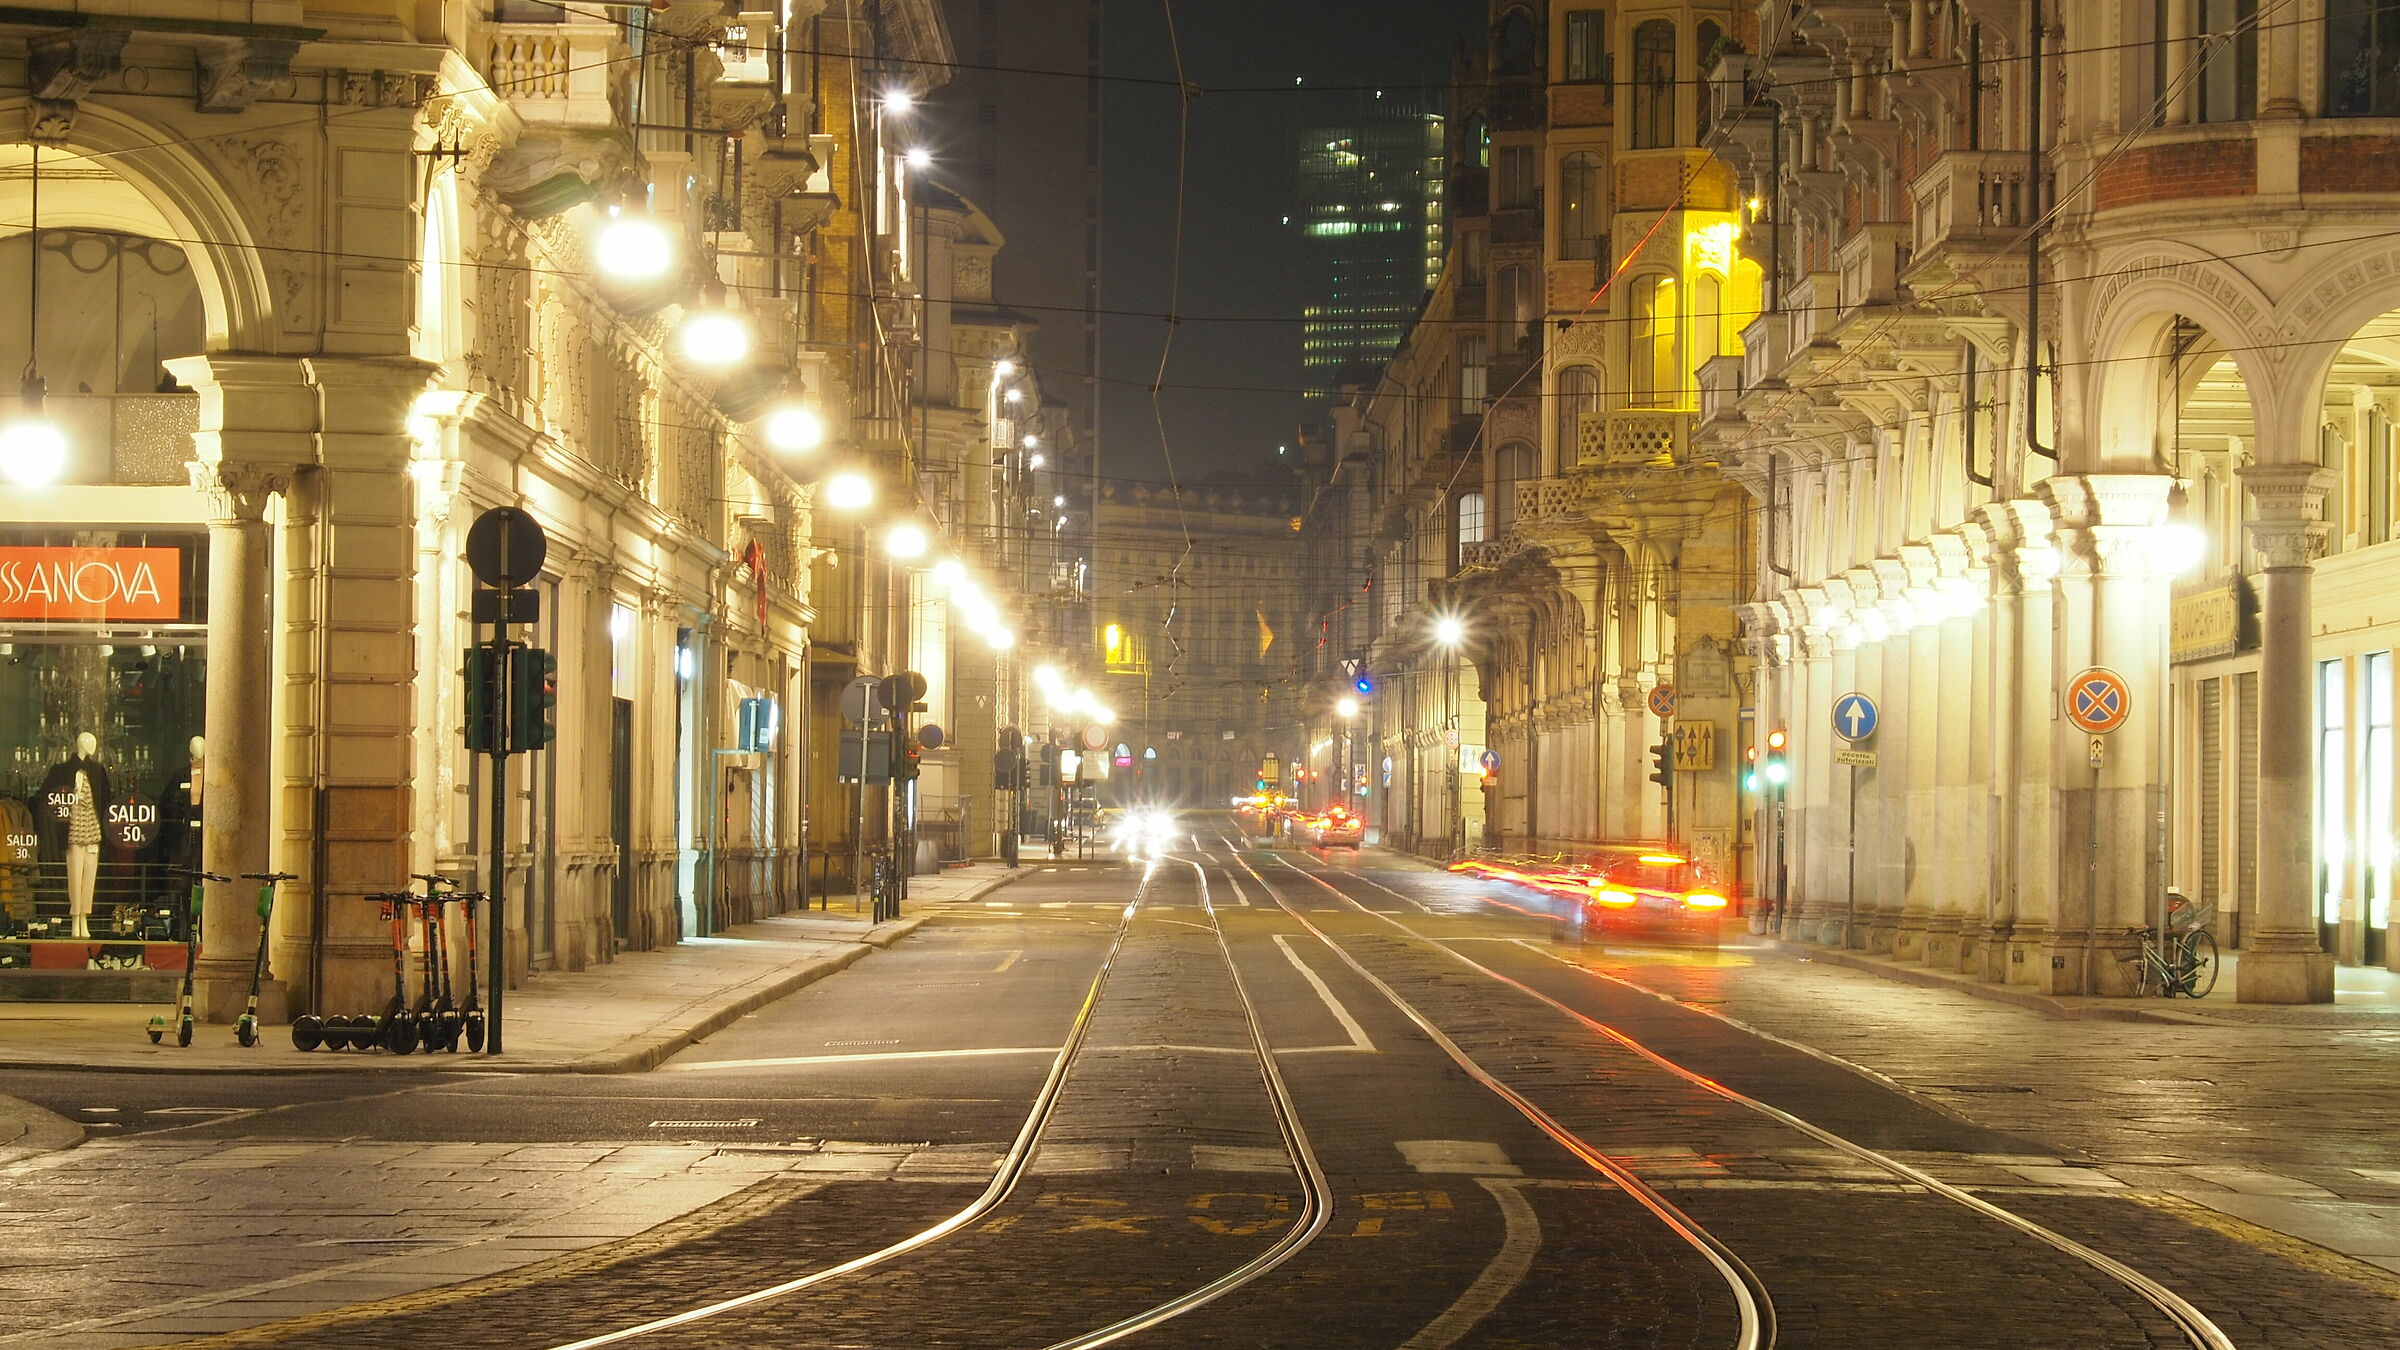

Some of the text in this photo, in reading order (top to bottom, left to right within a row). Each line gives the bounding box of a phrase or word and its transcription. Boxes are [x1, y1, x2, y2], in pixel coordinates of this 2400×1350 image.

[0, 561, 161, 604] SSANOVA
[47, 792, 79, 805] SALDI
[108, 804, 155, 823] SALDI
[6, 834, 38, 846] SALDI
